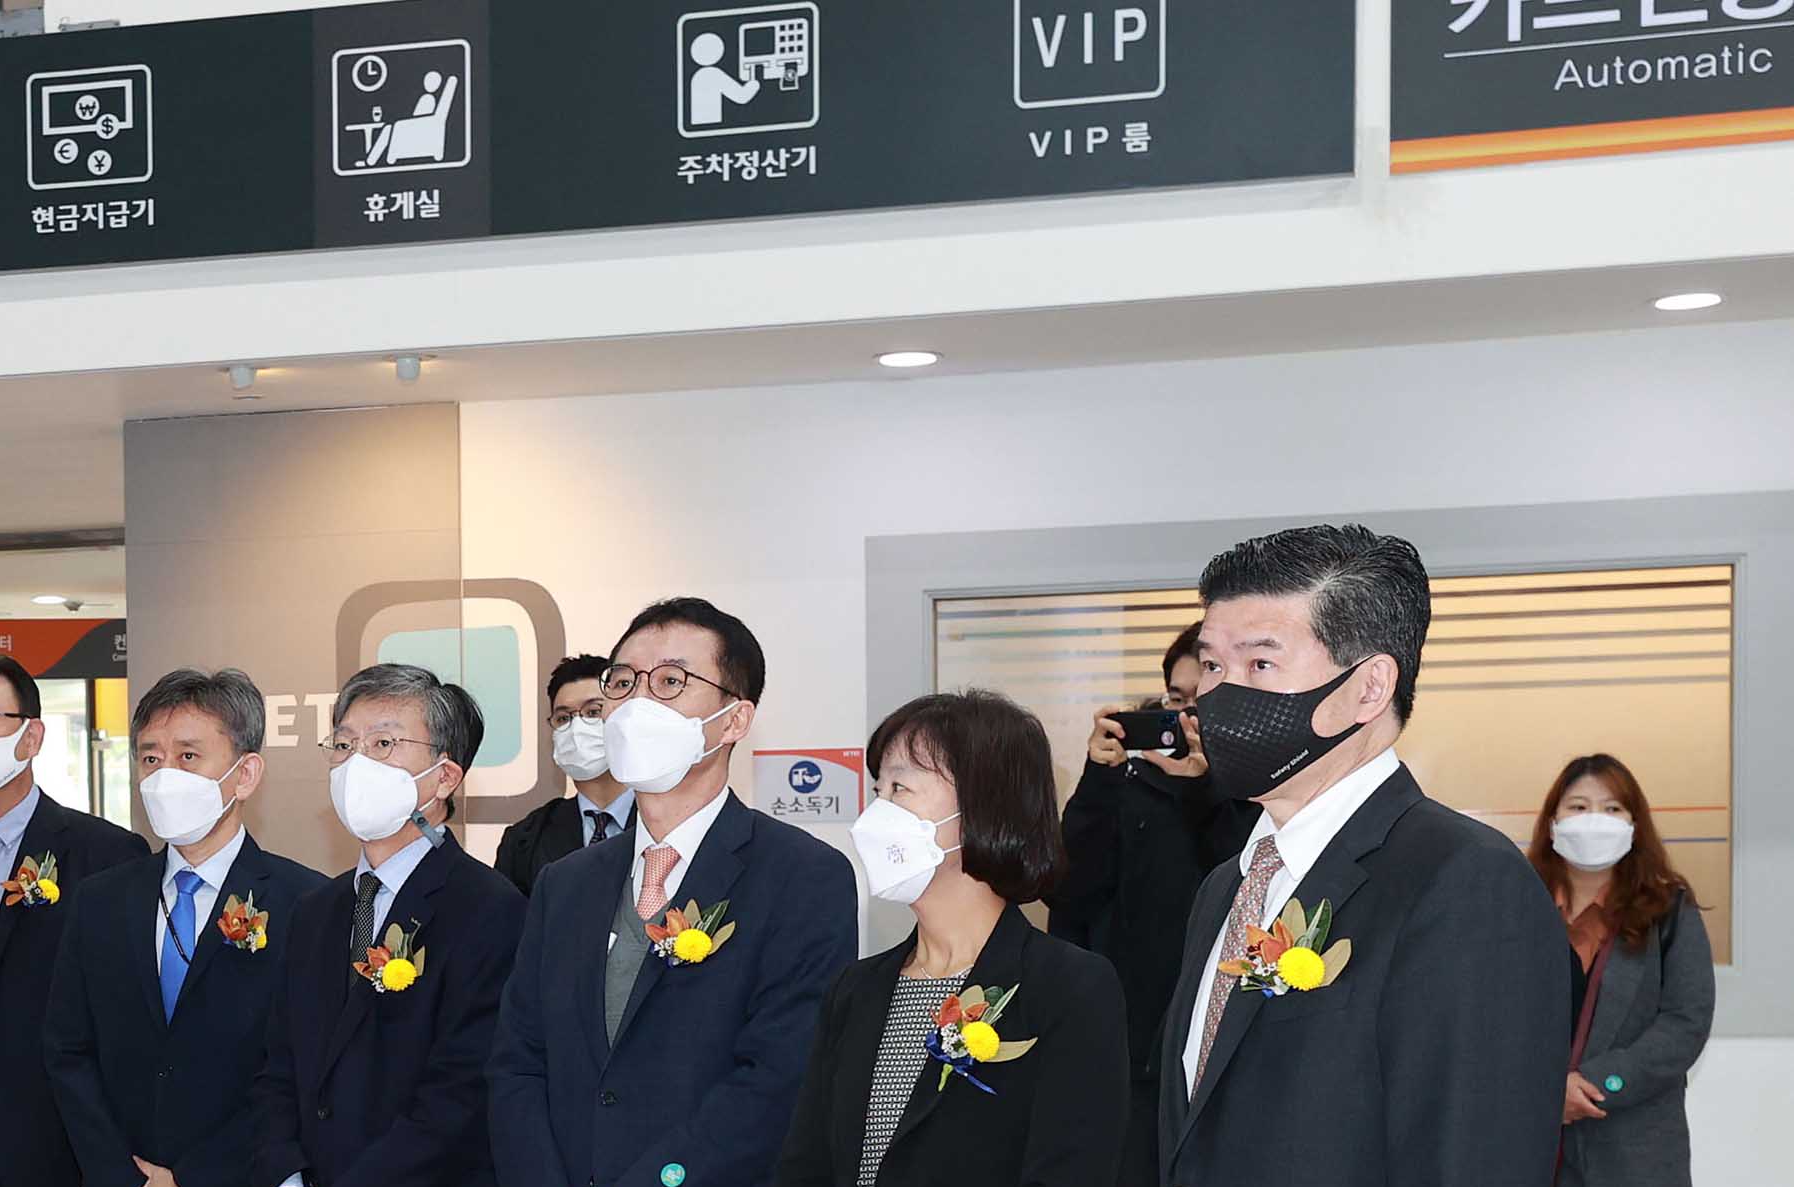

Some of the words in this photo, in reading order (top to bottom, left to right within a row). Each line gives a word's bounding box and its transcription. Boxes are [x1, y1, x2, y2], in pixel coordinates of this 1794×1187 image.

[1031, 7, 1148, 69] VIP
[1554, 43, 1774, 91] Automatic
[677, 145, 817, 185] 주차정산기
[31, 198, 155, 234] 현금지급기
[363, 190, 441, 222] 휴게실
[770, 796, 841, 816] 손소독기
